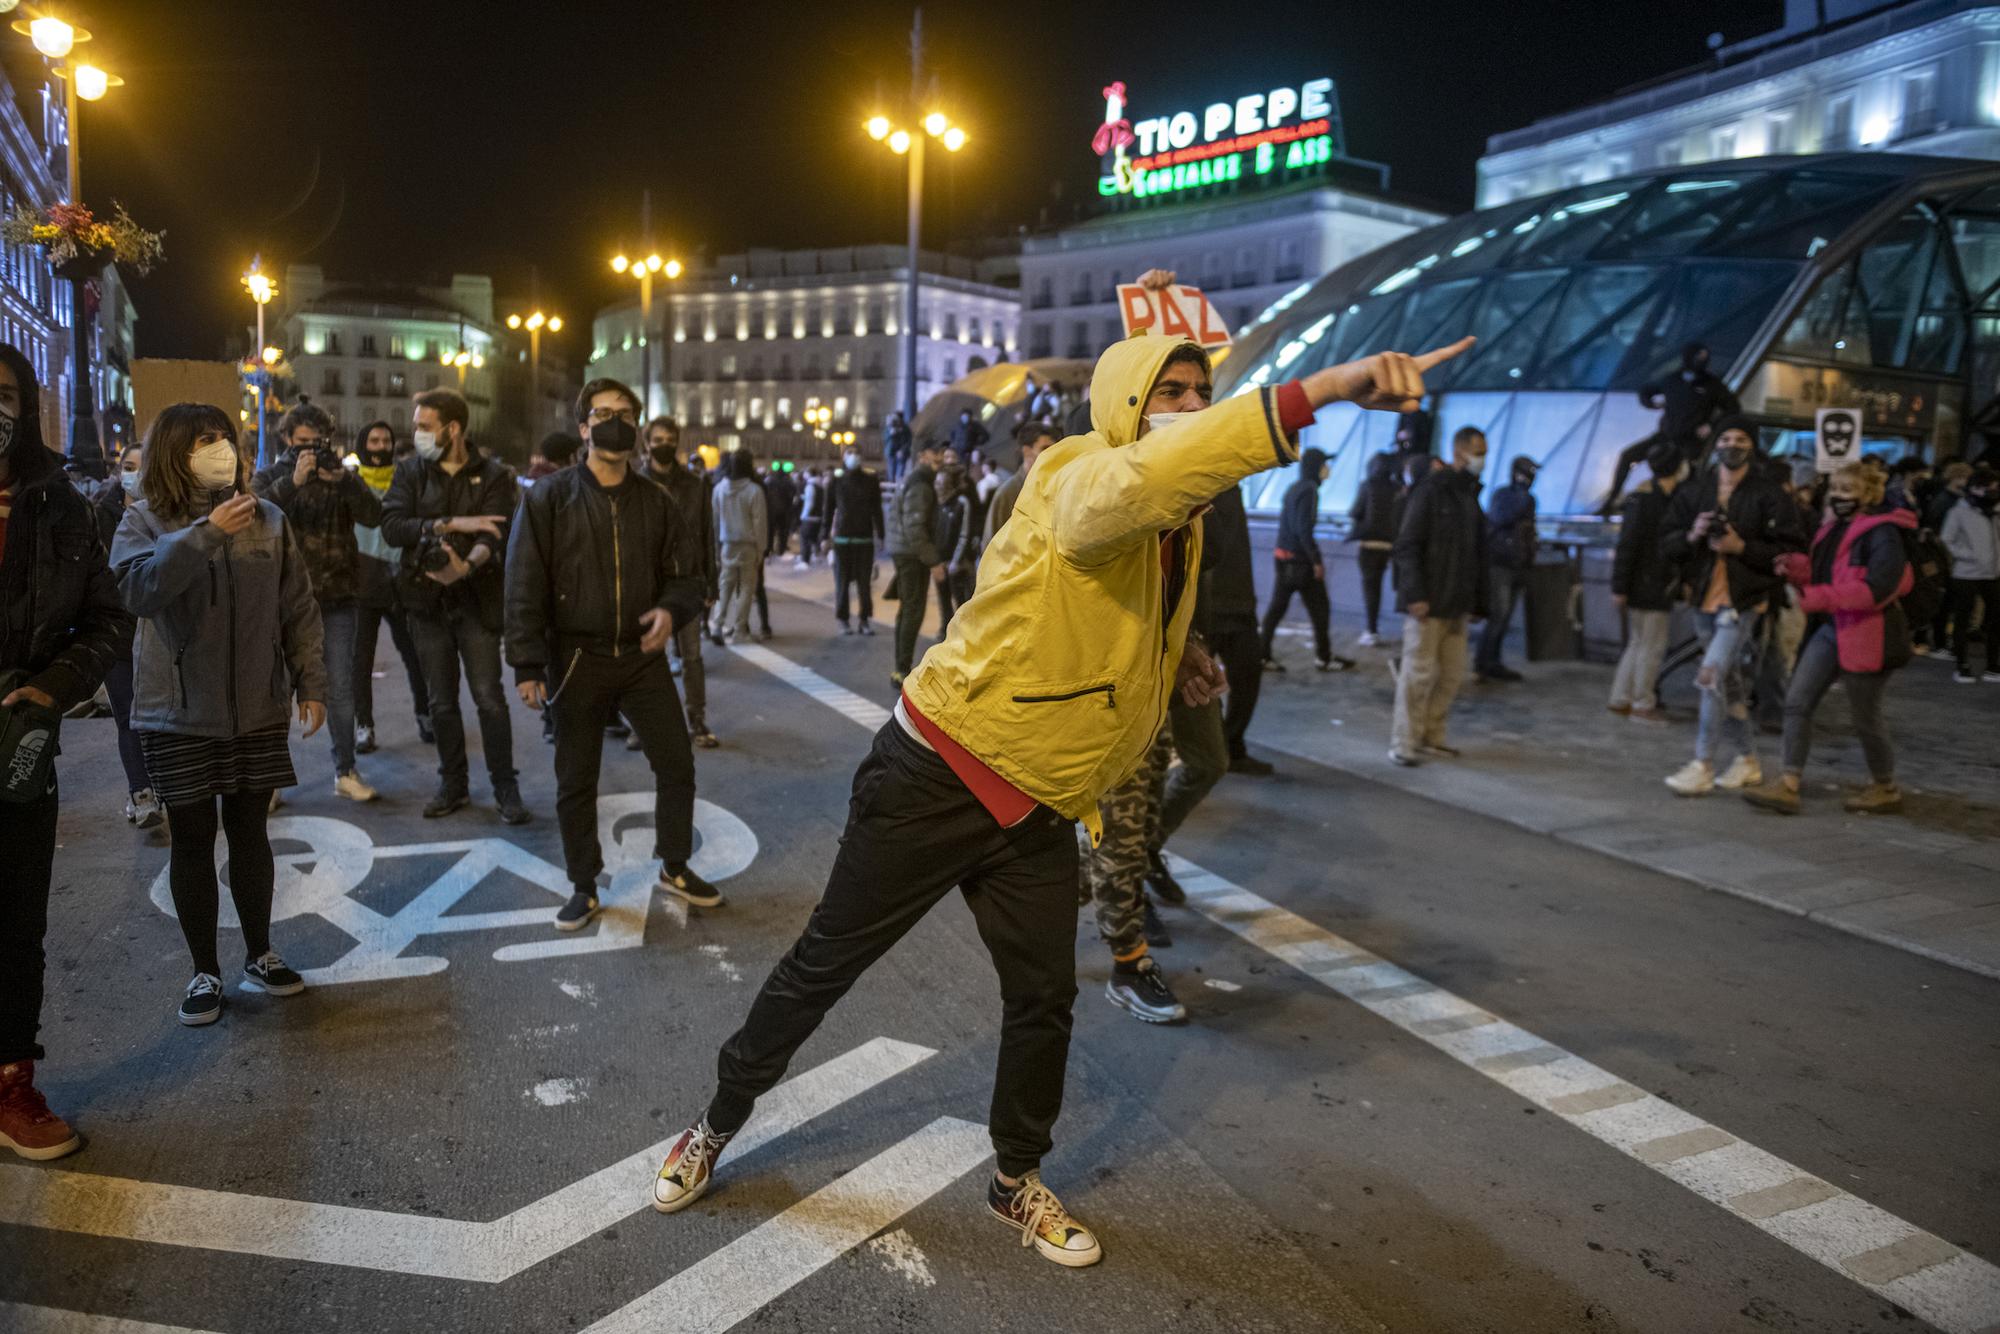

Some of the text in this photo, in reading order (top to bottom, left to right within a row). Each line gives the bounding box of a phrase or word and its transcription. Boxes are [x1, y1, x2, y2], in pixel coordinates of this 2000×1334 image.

[1134, 110, 1197, 155] TIO
[1204, 77, 1333, 142] PEPE
[7, 748, 34, 789] NORTH
[8, 745, 23, 768] THE
[22, 751, 39, 780] FACE
